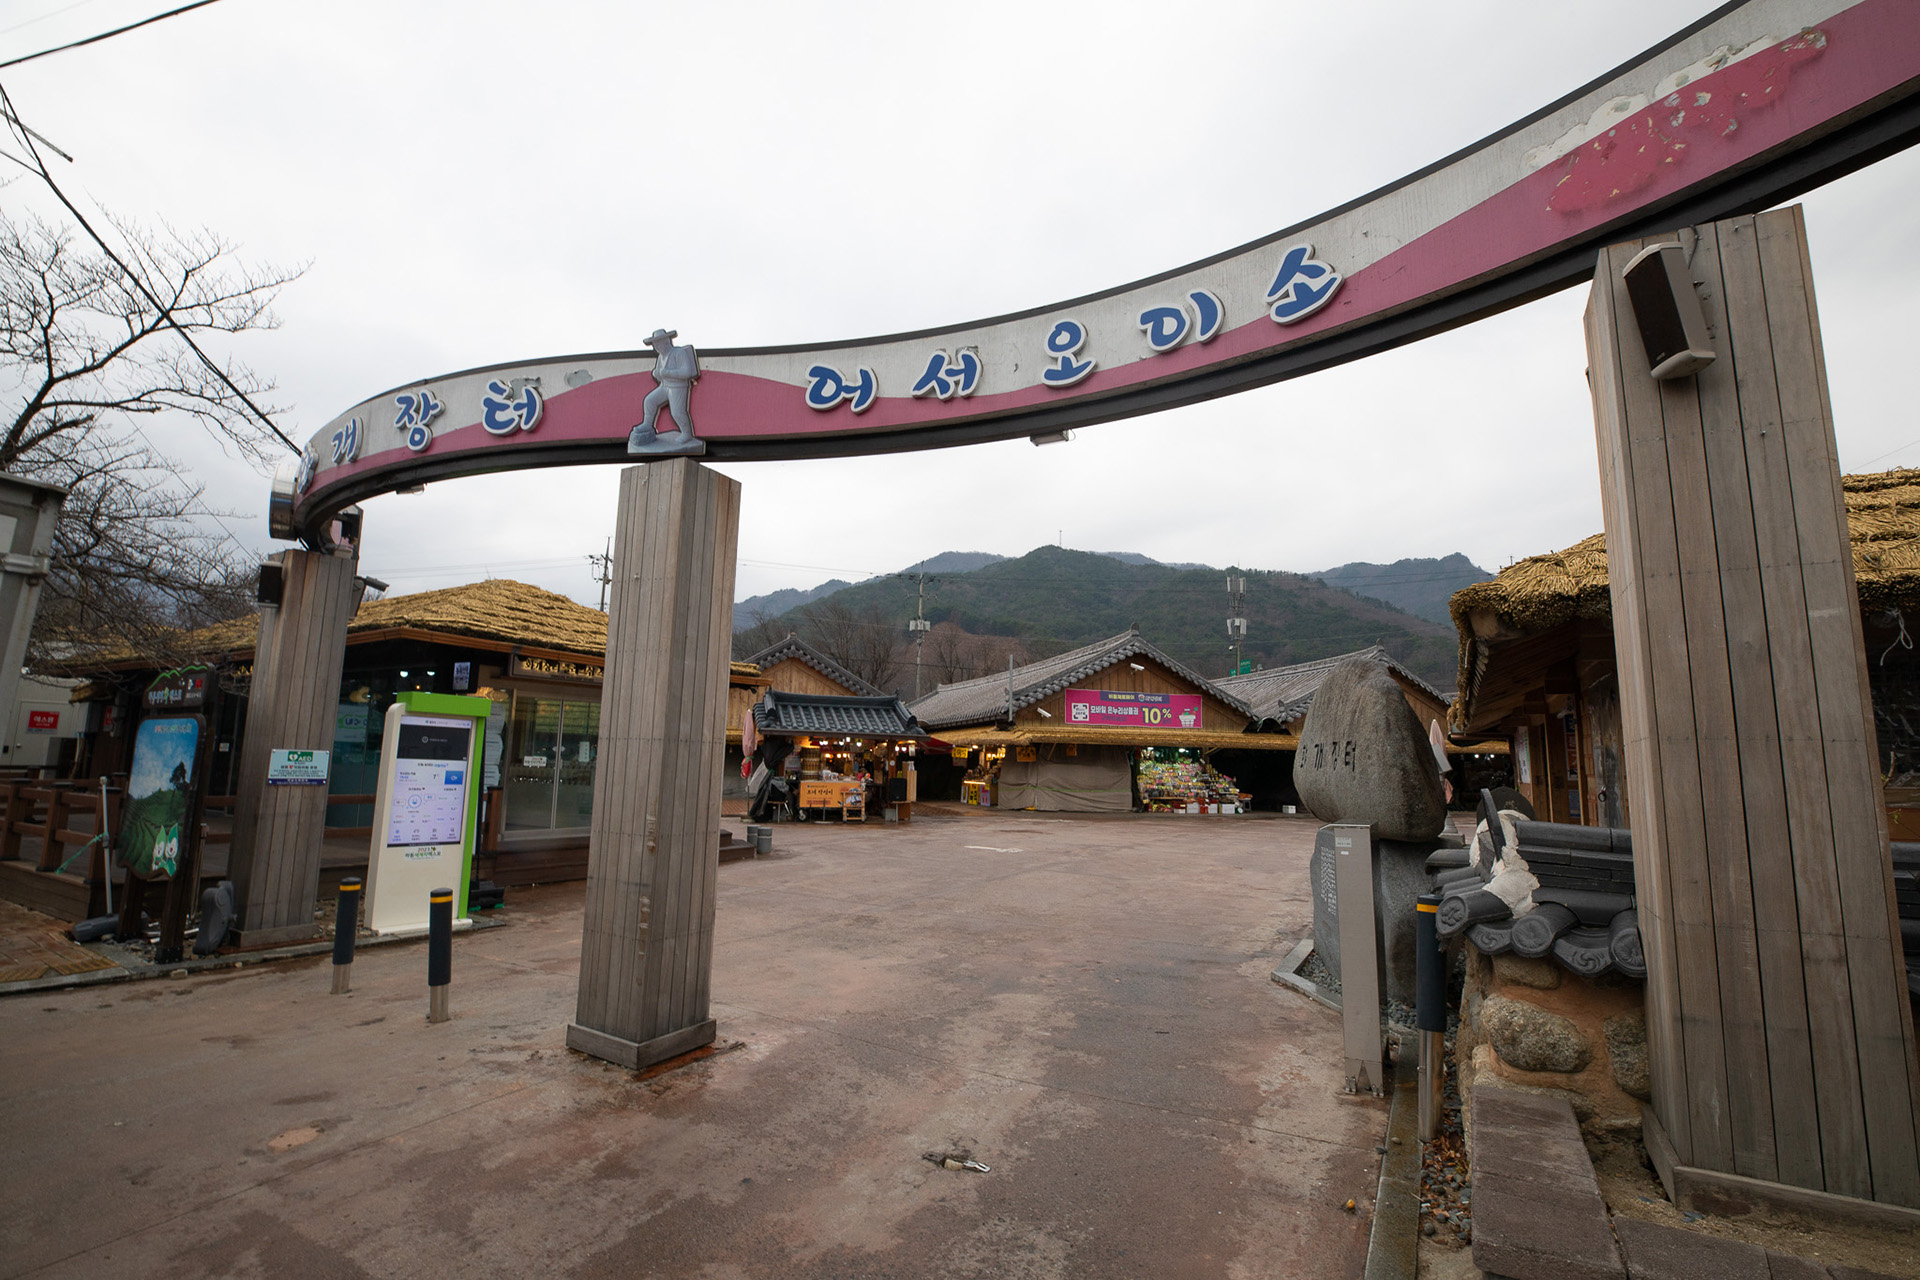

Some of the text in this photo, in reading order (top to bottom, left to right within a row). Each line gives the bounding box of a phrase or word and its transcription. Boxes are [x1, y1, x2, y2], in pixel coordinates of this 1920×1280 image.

[1090, 705, 1106, 714] 모바일
[1107, 706, 1139, 715] 온누리상품권
[1300, 741, 1357, 772] 화개장터
